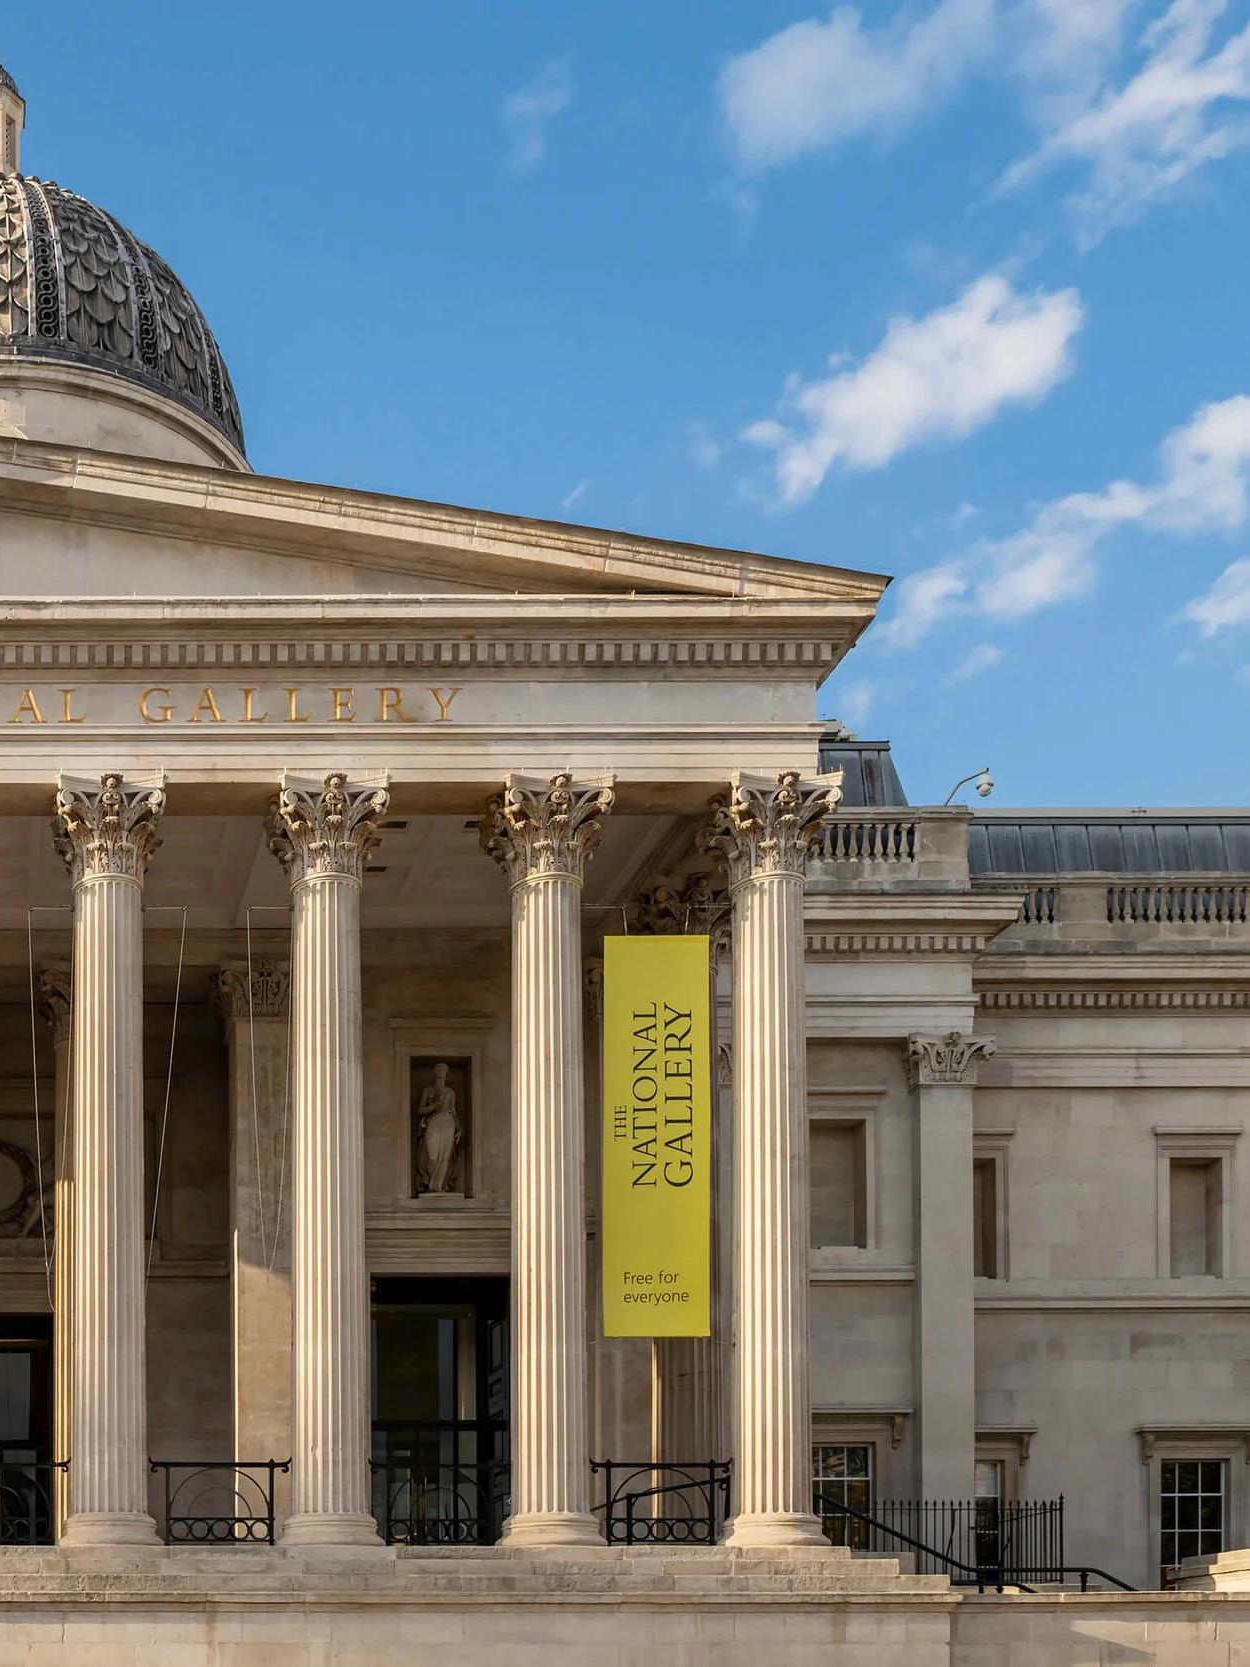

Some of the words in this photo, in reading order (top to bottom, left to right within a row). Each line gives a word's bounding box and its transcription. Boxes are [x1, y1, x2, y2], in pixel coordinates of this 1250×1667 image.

[139, 687, 463, 724] GALLERY
[632, 1001, 658, 1188] NATIONAL
[664, 1001, 693, 1188] GALLERY
[614, 1105, 626, 1141] THE
[623, 1271, 653, 1284] Free
[658, 1270, 679, 1284] for
[623, 1290, 689, 1306] everyone
